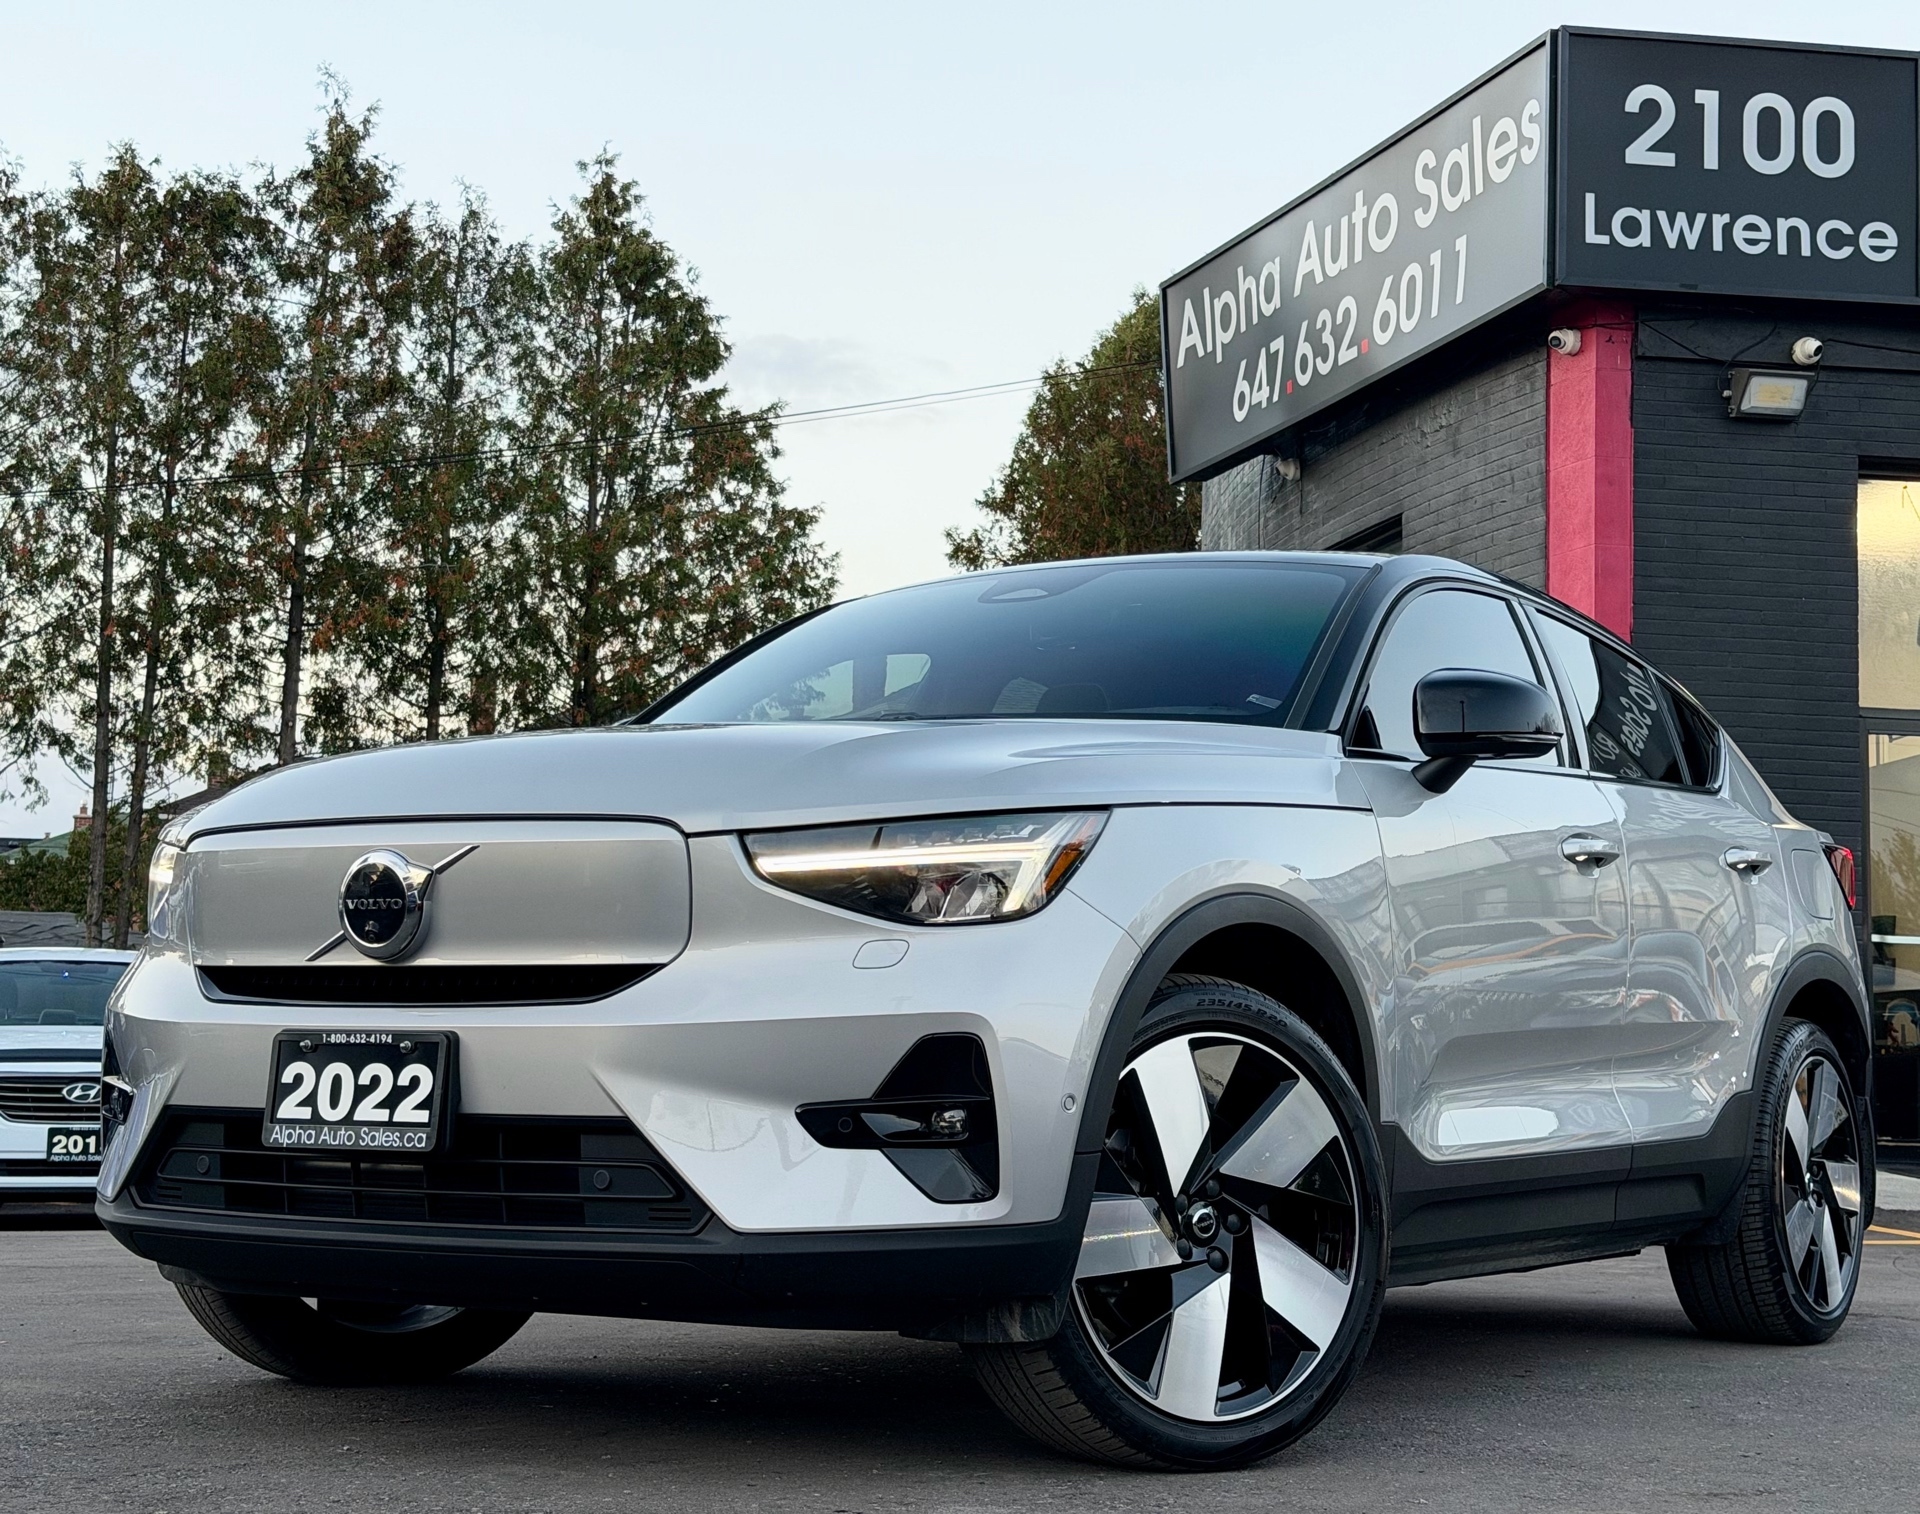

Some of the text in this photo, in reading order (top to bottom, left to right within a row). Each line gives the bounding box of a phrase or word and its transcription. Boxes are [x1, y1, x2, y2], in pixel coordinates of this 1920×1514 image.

[1624, 83, 1855, 179] 2100
[1176, 98, 1541, 369] Alpha Auto Sales
[1584, 192, 1899, 263] Lawrence
[1232, 234, 1467, 422] 647.632.6011
[345, 898, 403, 910] VOLVO
[1196, 998, 1253, 1012] 235/45
[322, 1034, 393, 1044] 1-800-632-4194
[276, 1061, 434, 1123] 2022
[51, 1134, 99, 1154] 201
[270, 1125, 427, 1148] Alpha Auto Sales.ca
